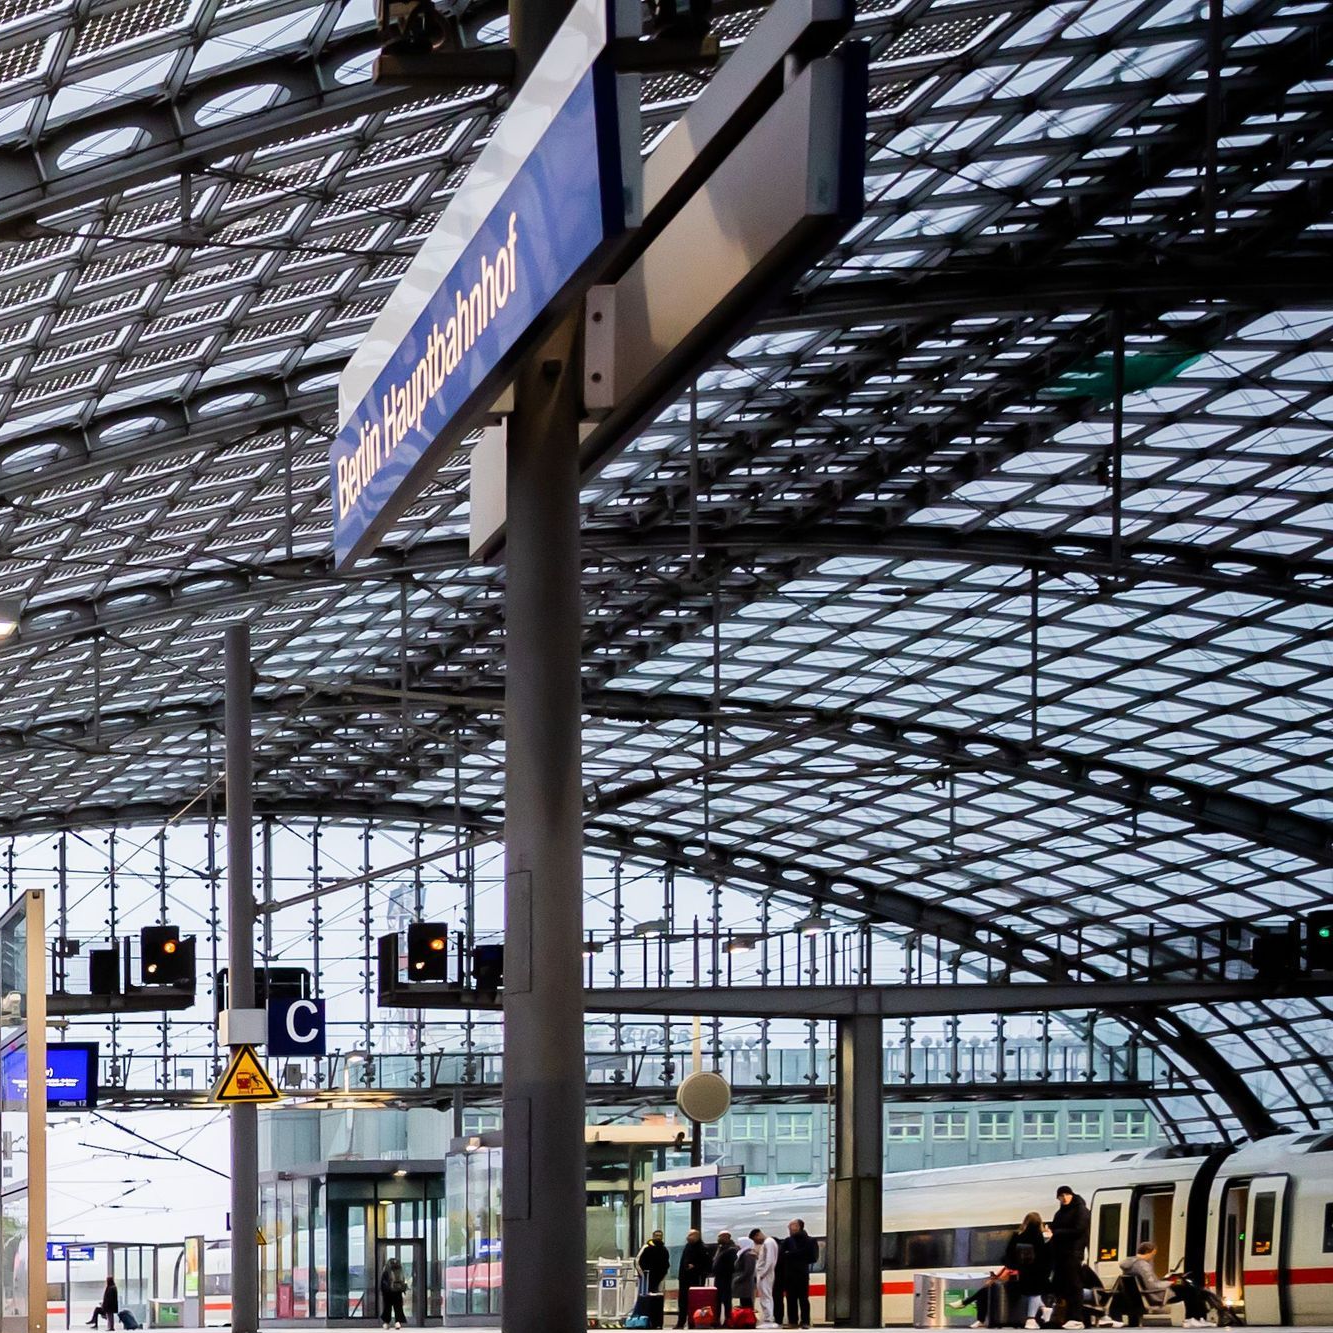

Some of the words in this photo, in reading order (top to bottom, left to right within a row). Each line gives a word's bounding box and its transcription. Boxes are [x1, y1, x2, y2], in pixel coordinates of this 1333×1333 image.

[337, 420, 381, 521] Berlin
[383, 211, 517, 458] Hauptbahnhof
[286, 999, 319, 1043] C
